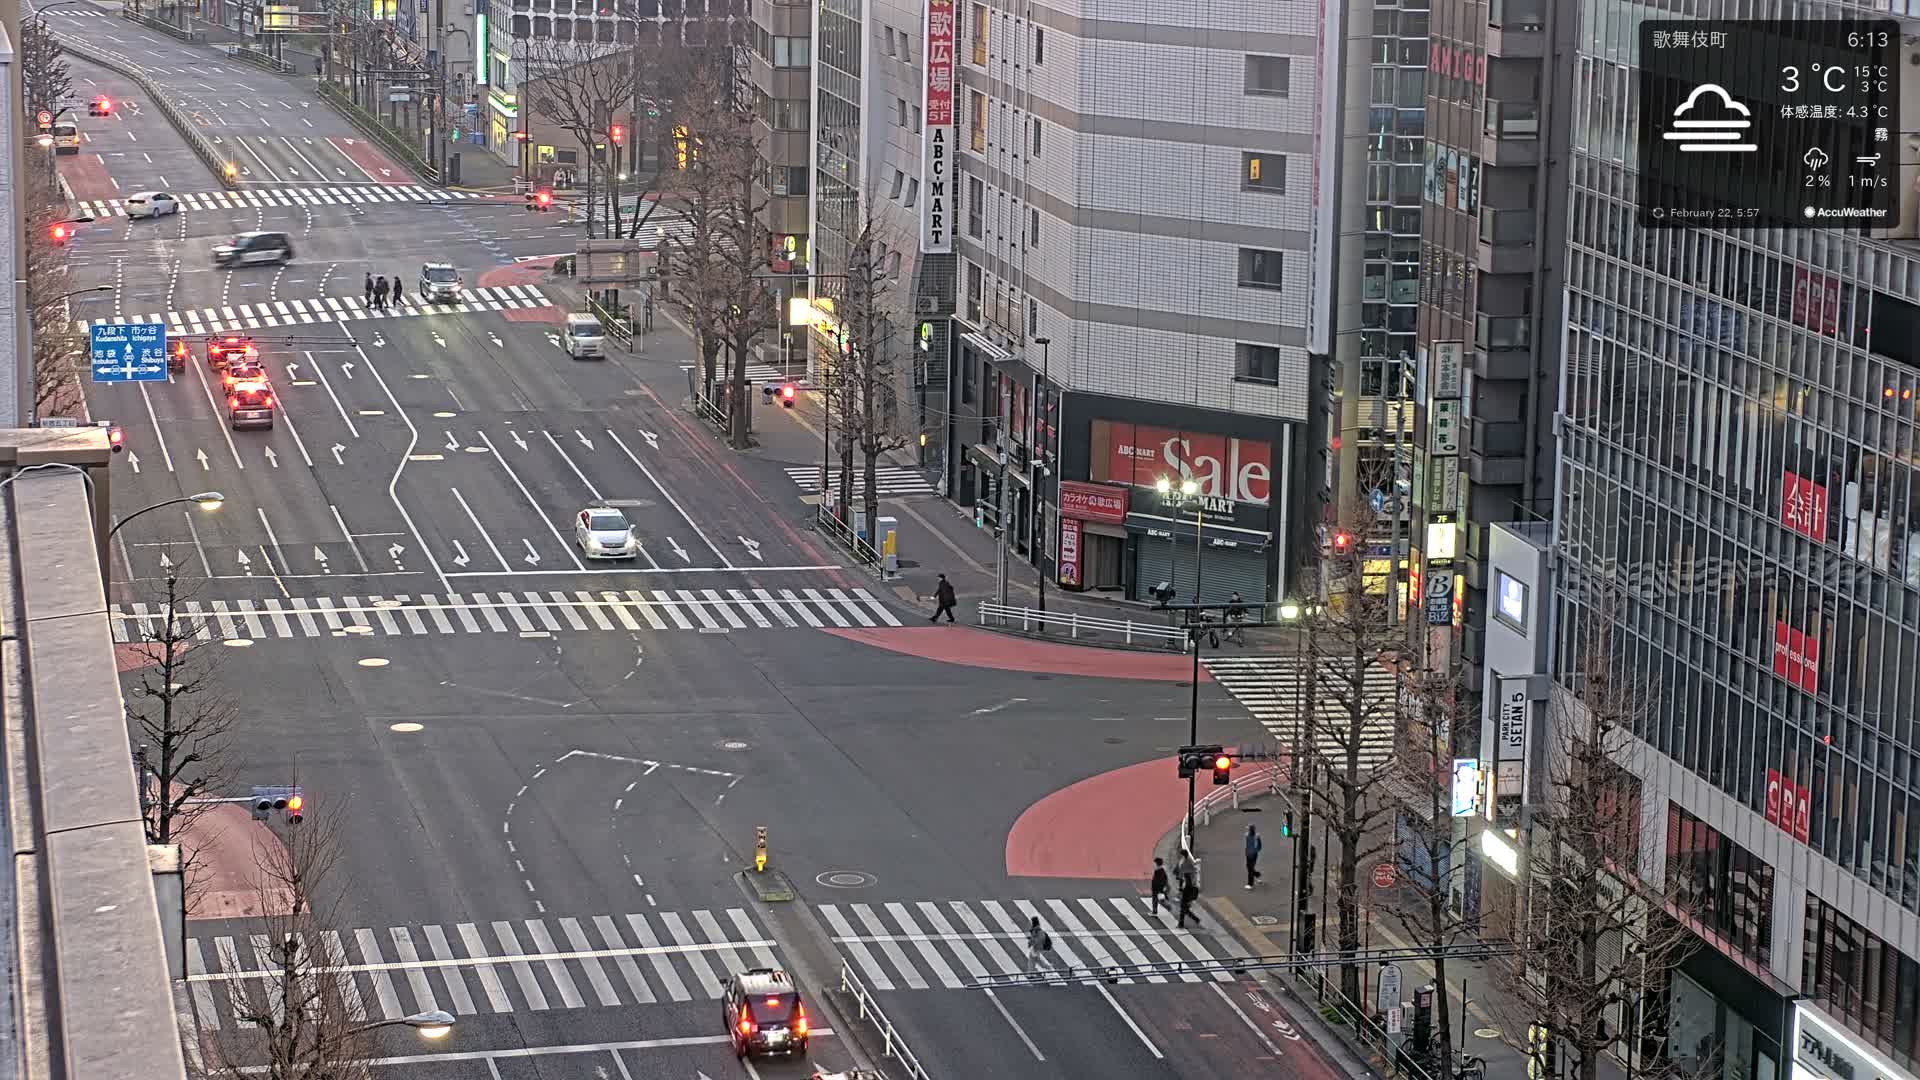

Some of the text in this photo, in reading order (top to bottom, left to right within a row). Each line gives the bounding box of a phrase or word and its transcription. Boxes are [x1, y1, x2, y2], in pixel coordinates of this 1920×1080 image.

[1430, 46, 1484, 84] AMIGO
[928, 111, 950, 120] 5F
[97, 326, 125, 335] 九段下
[132, 335, 157, 343] Ichigaya
[94, 347, 163, 358] 池袋 渋谷
[141, 356, 164, 365] Shibuya
[1163, 437, 1270, 506] Sale
[1787, 482, 1823, 533] 会計
[1501, 703, 1510, 741] PARK CITY
[1510, 692, 1524, 748] ISETAN 5
[1767, 780, 1808, 831] CPA
